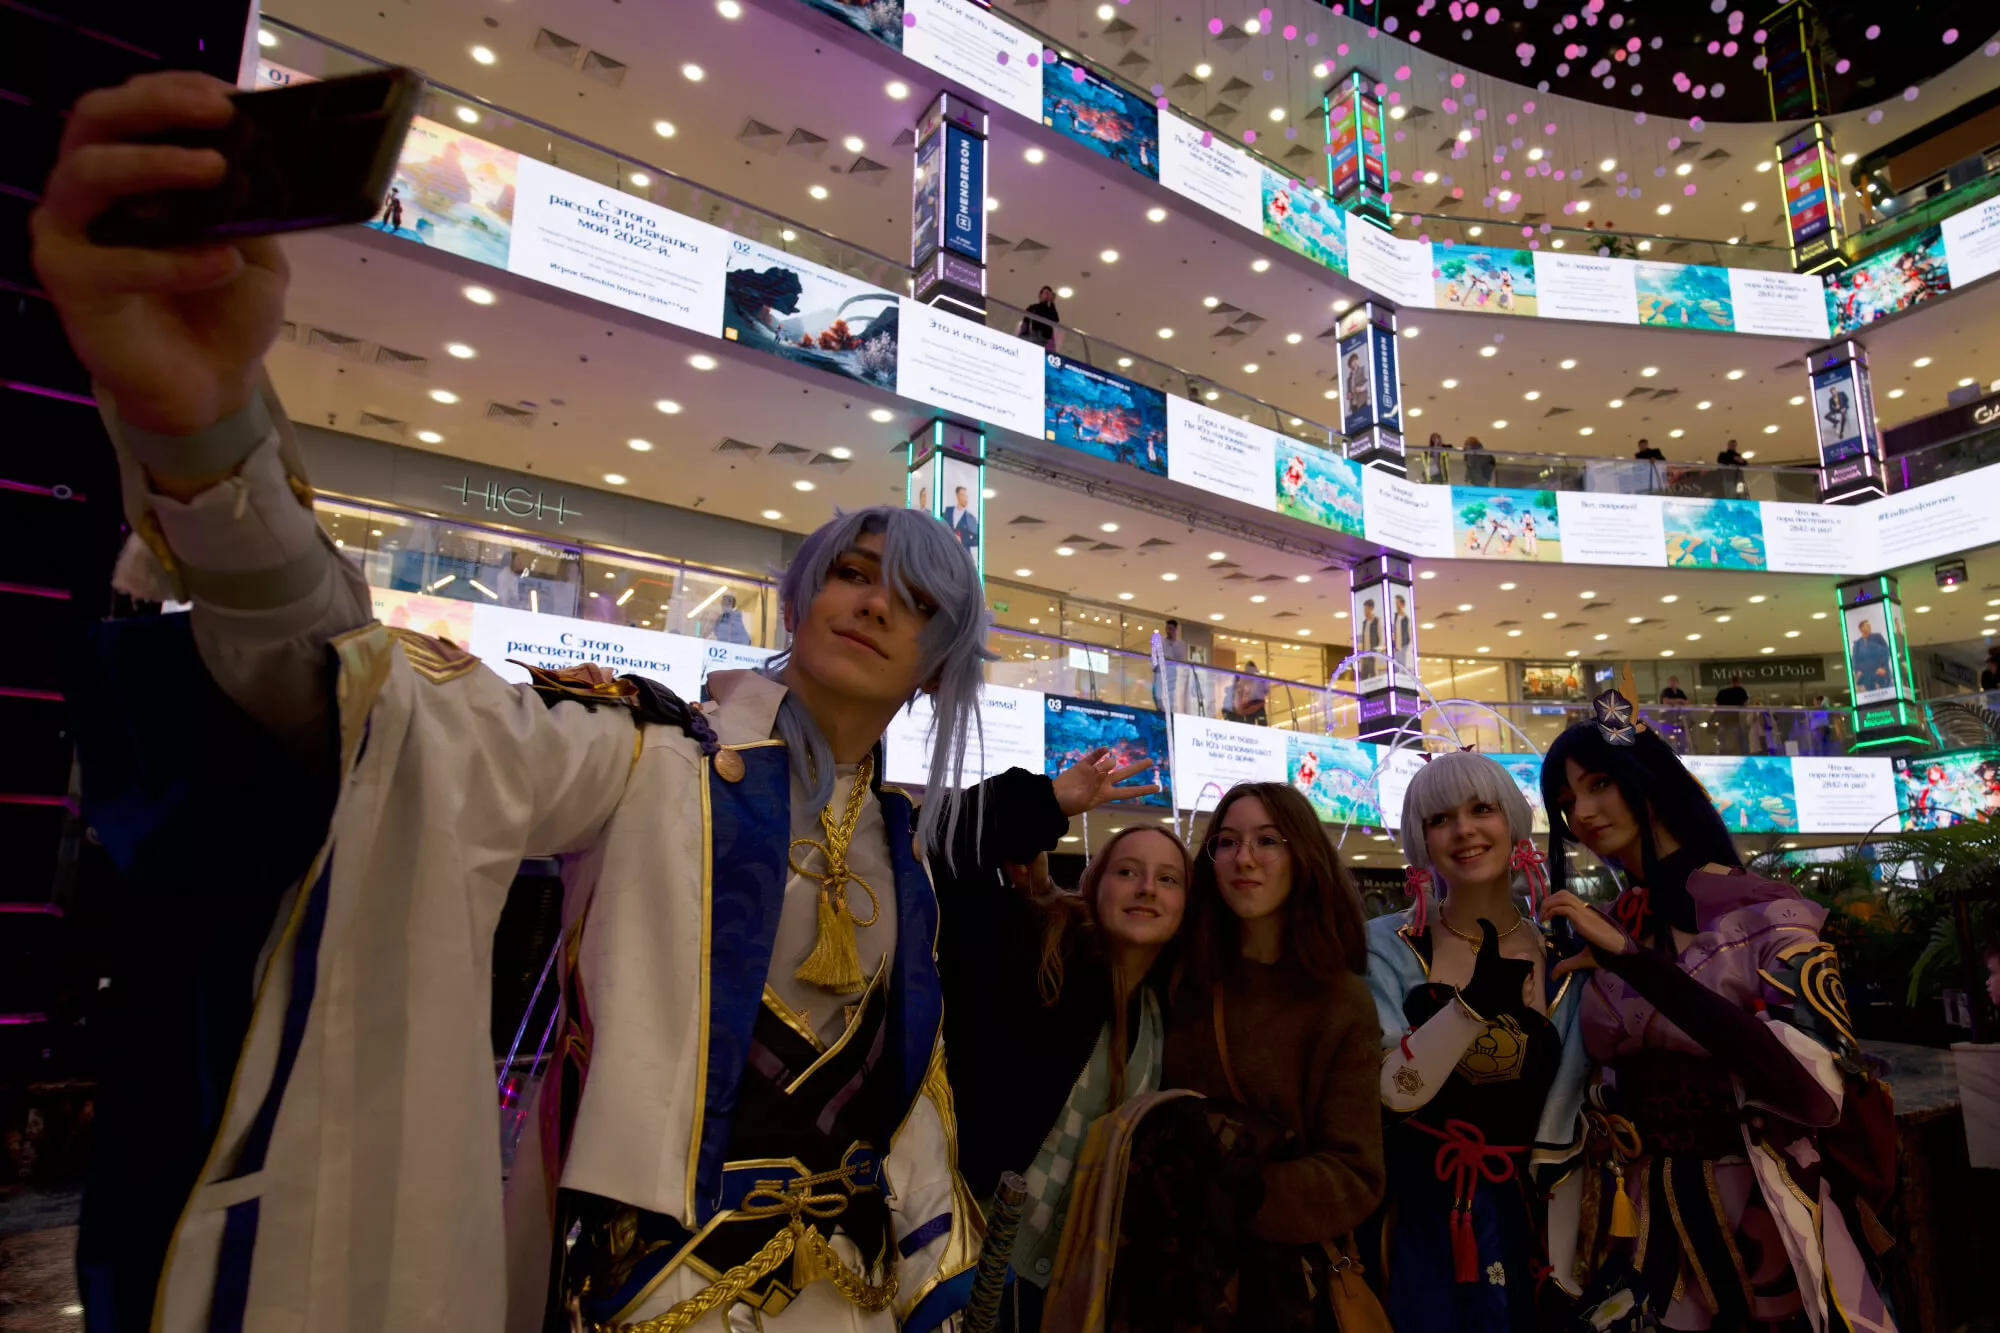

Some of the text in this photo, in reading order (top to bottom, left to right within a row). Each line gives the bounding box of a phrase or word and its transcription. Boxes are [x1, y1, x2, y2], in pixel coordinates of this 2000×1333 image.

[958, 139, 971, 214] HENDERSON
[598, 198, 656, 228] С этого
[549, 194, 699, 254] рассвета и начался
[578, 218, 610, 236] мой
[733, 240, 751, 253] 02
[929, 318, 1019, 358] Это и есть зима!
[1048, 354, 1062, 367] 03
[443, 476, 582, 524] HIGH
[560, 632, 624, 654] С этого
[507, 640, 586, 660] рассвета
[590, 652, 600, 661] и
[606, 656, 671, 672] начался
[708, 647, 728, 660] 02
[1712, 664, 1816, 680] Marc O'Polo
[985, 700, 1017, 711] зима!
[1048, 698, 1062, 710] 03
